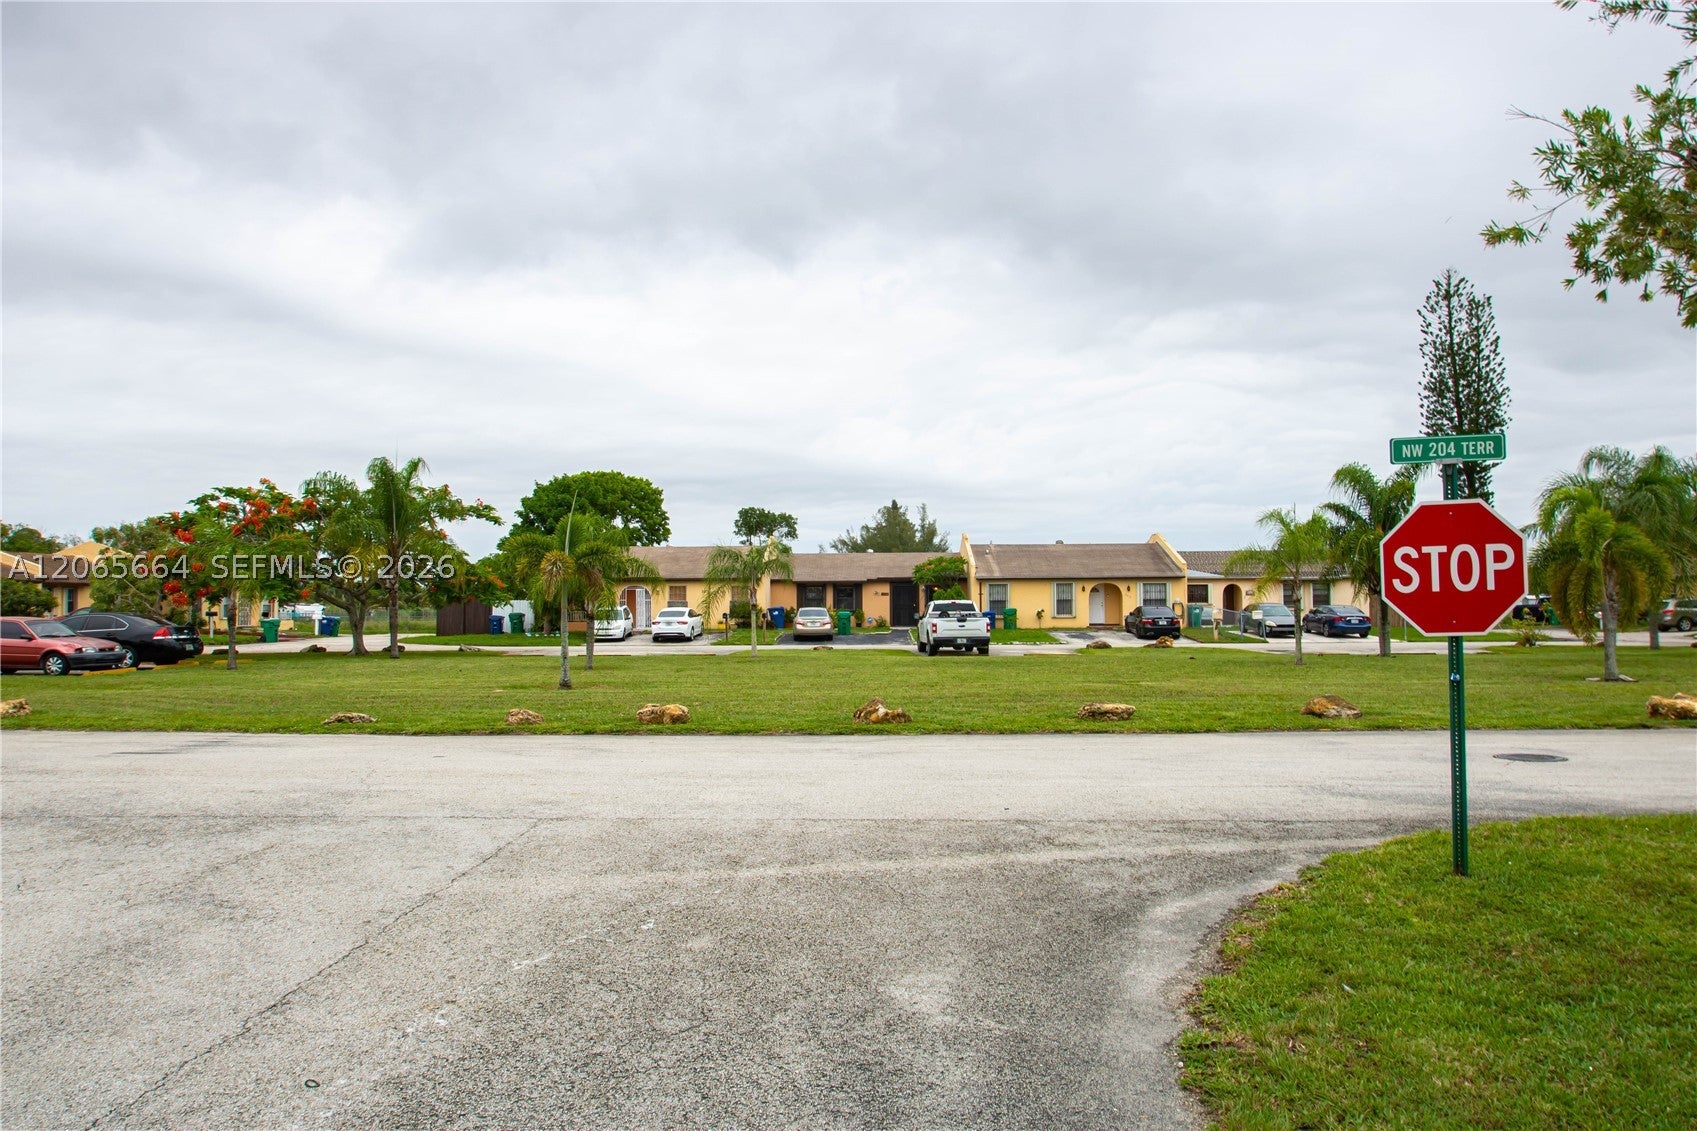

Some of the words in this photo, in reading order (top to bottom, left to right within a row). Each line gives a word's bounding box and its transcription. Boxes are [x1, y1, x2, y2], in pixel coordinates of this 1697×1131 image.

[1402, 444, 1422, 458] NW
[1429, 441, 1456, 457] 204
[1461, 440, 1495, 456] TERR
[1392, 543, 1515, 594] STOP
